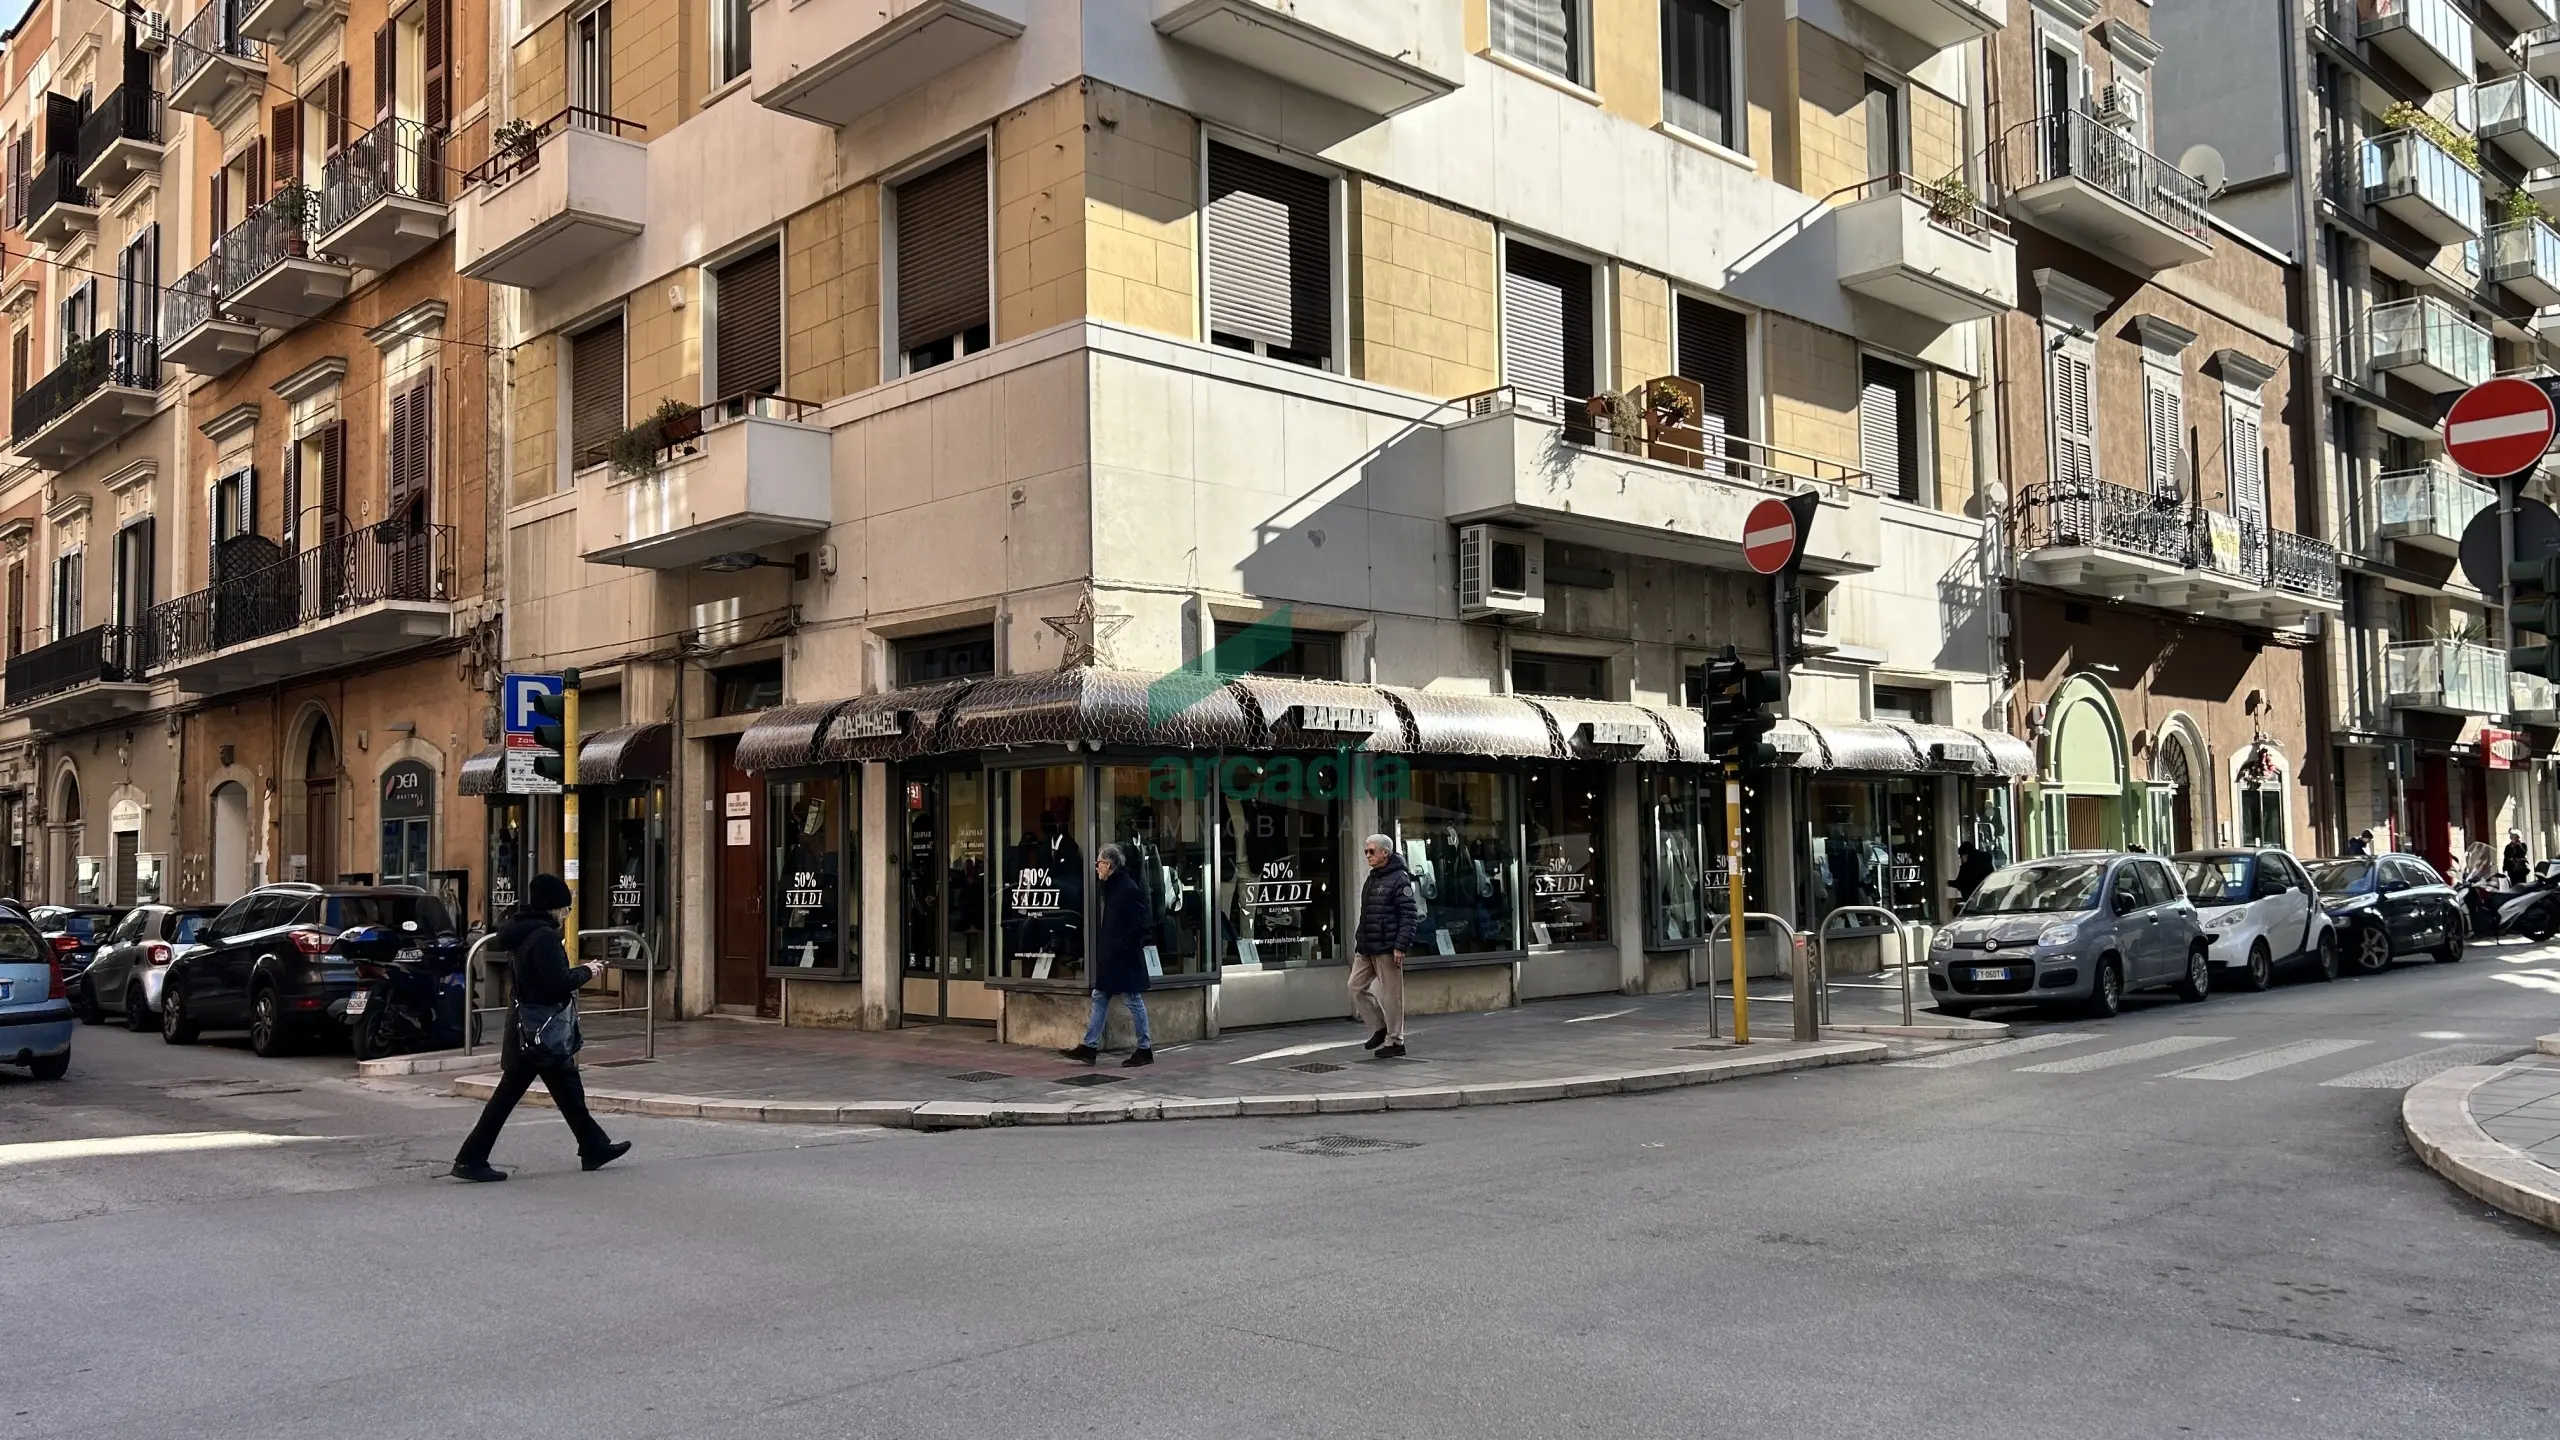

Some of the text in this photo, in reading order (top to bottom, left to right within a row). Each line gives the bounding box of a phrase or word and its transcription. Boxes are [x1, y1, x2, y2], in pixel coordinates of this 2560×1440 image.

[517, 681, 551, 727] P
[835, 710, 902, 740] RAPHAEL
[1302, 705, 1383, 733] RAPHAEL
[396, 772, 418, 789] DEA
[1549, 857, 1573, 873] 50%
[1895, 853, 1913, 865] 50%
[1023, 868, 1052, 887] 50%
[1262, 862, 1293, 879] 50%
[1894, 868, 1921, 880] ALDI
[496, 876, 511, 890] 50%
[619, 874, 637, 889] 50%
[794, 871, 817, 888] 50%
[1535, 876, 1585, 893] SALDI
[1704, 872, 1746, 887] SALI
[612, 893, 641, 904] SALDI
[785, 892, 823, 905] SALDI
[1012, 892, 1060, 907] SALDI
[1245, 883, 1312, 903] SALDI
